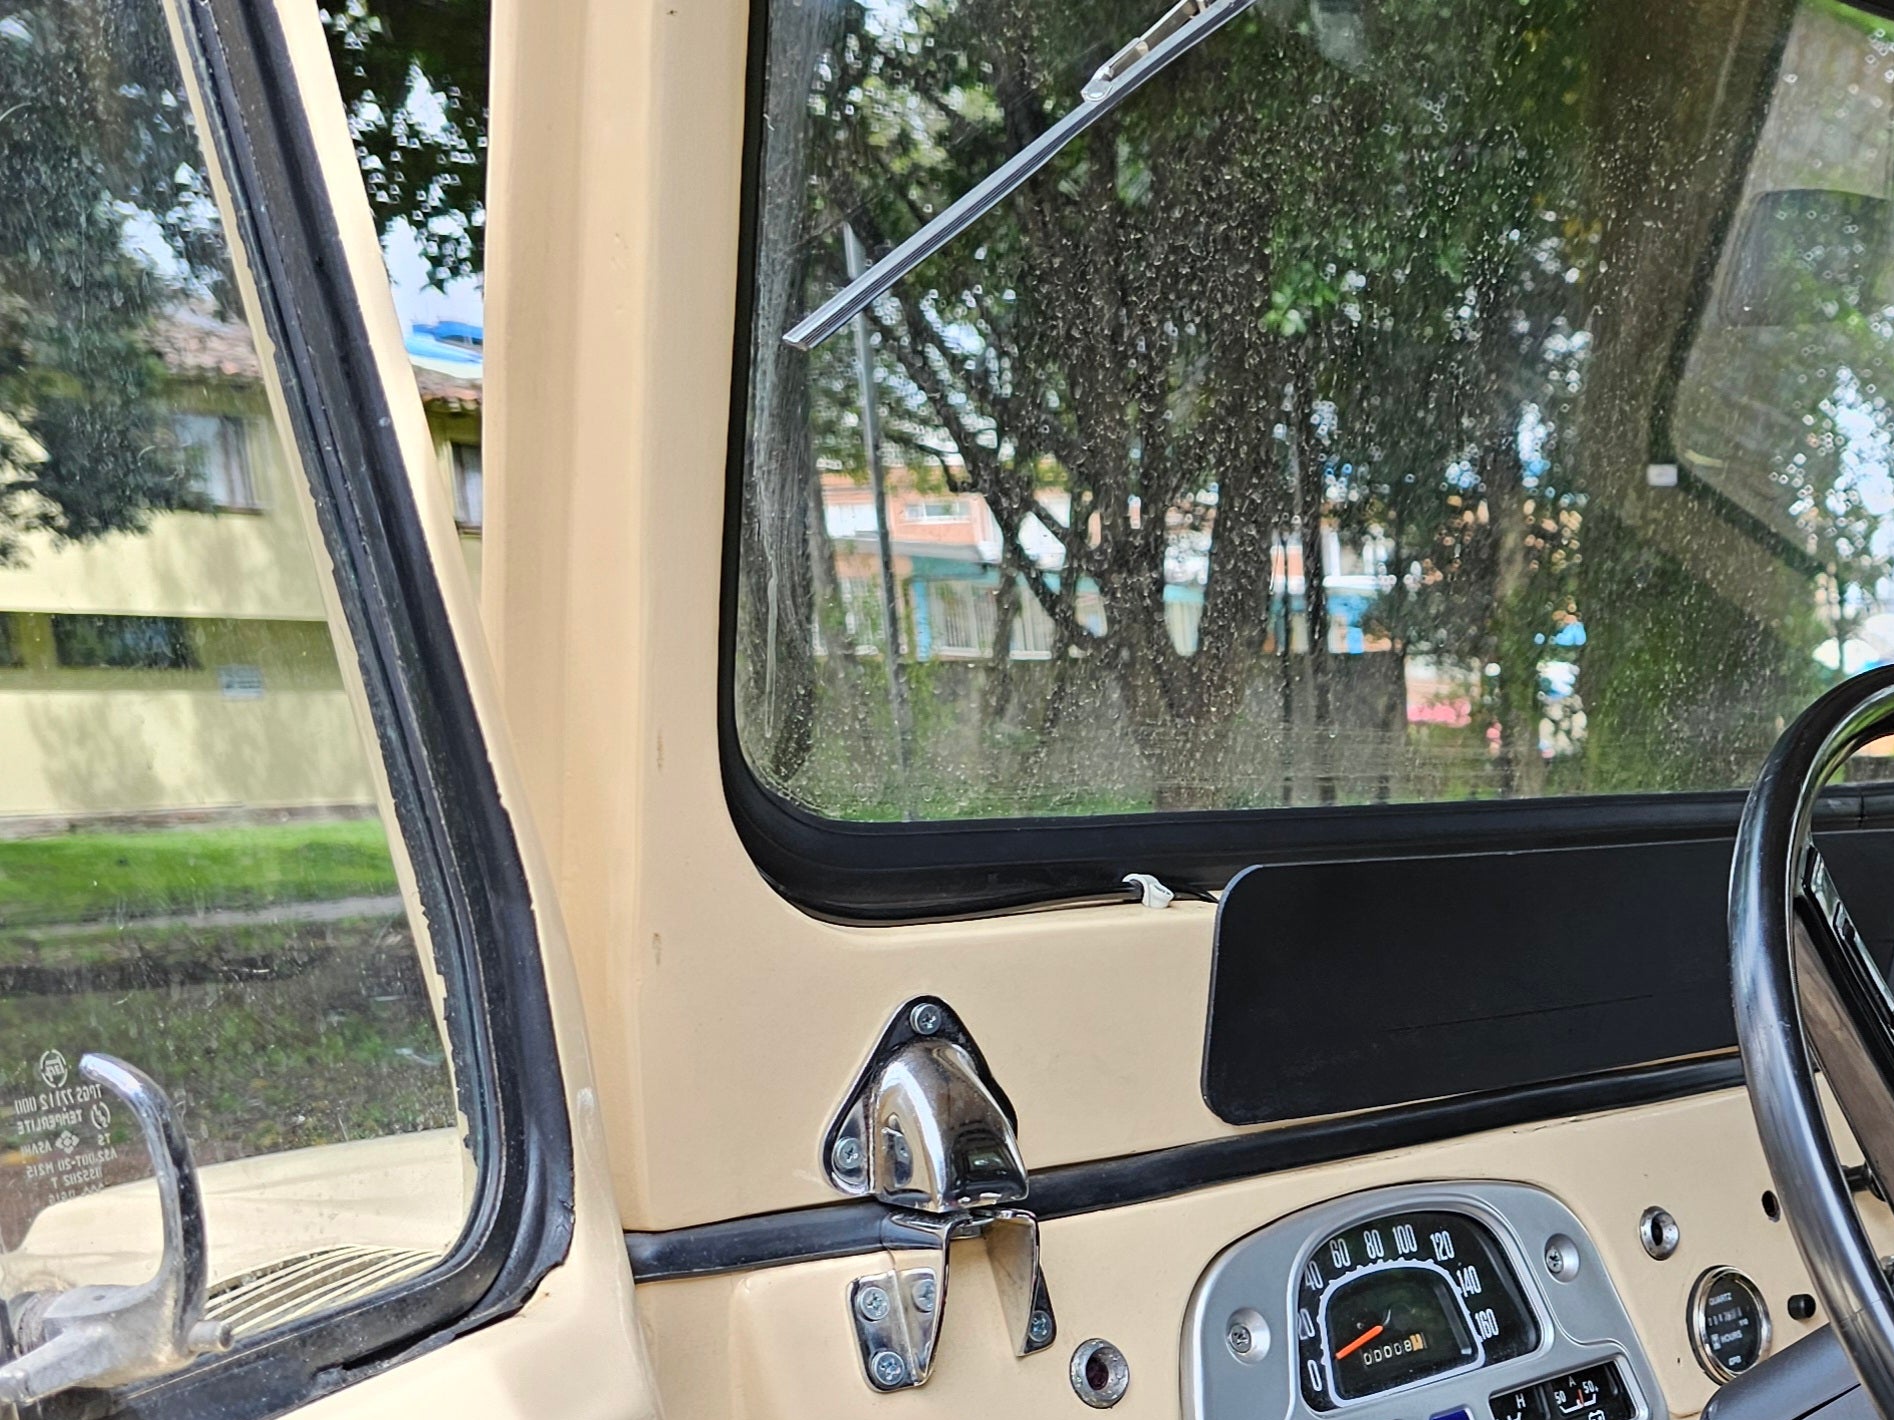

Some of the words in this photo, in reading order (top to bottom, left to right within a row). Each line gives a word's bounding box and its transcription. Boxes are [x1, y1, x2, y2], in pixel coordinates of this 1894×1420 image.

[1330, 1238, 1351, 1268] 60
[1363, 1229, 1384, 1259] 80
[1392, 1224, 1418, 1254] 100
[1430, 1231, 1455, 1261] 120
[1305, 1260, 1323, 1290] 40
[1457, 1266, 1482, 1297] 140
[1475, 1308, 1499, 1341] 160
[1307, 1359, 1322, 1391] 0
[1568, 1376, 1577, 1388] A
[1515, 1393, 1526, 1409] H
[1554, 1390, 1567, 1404] 50
